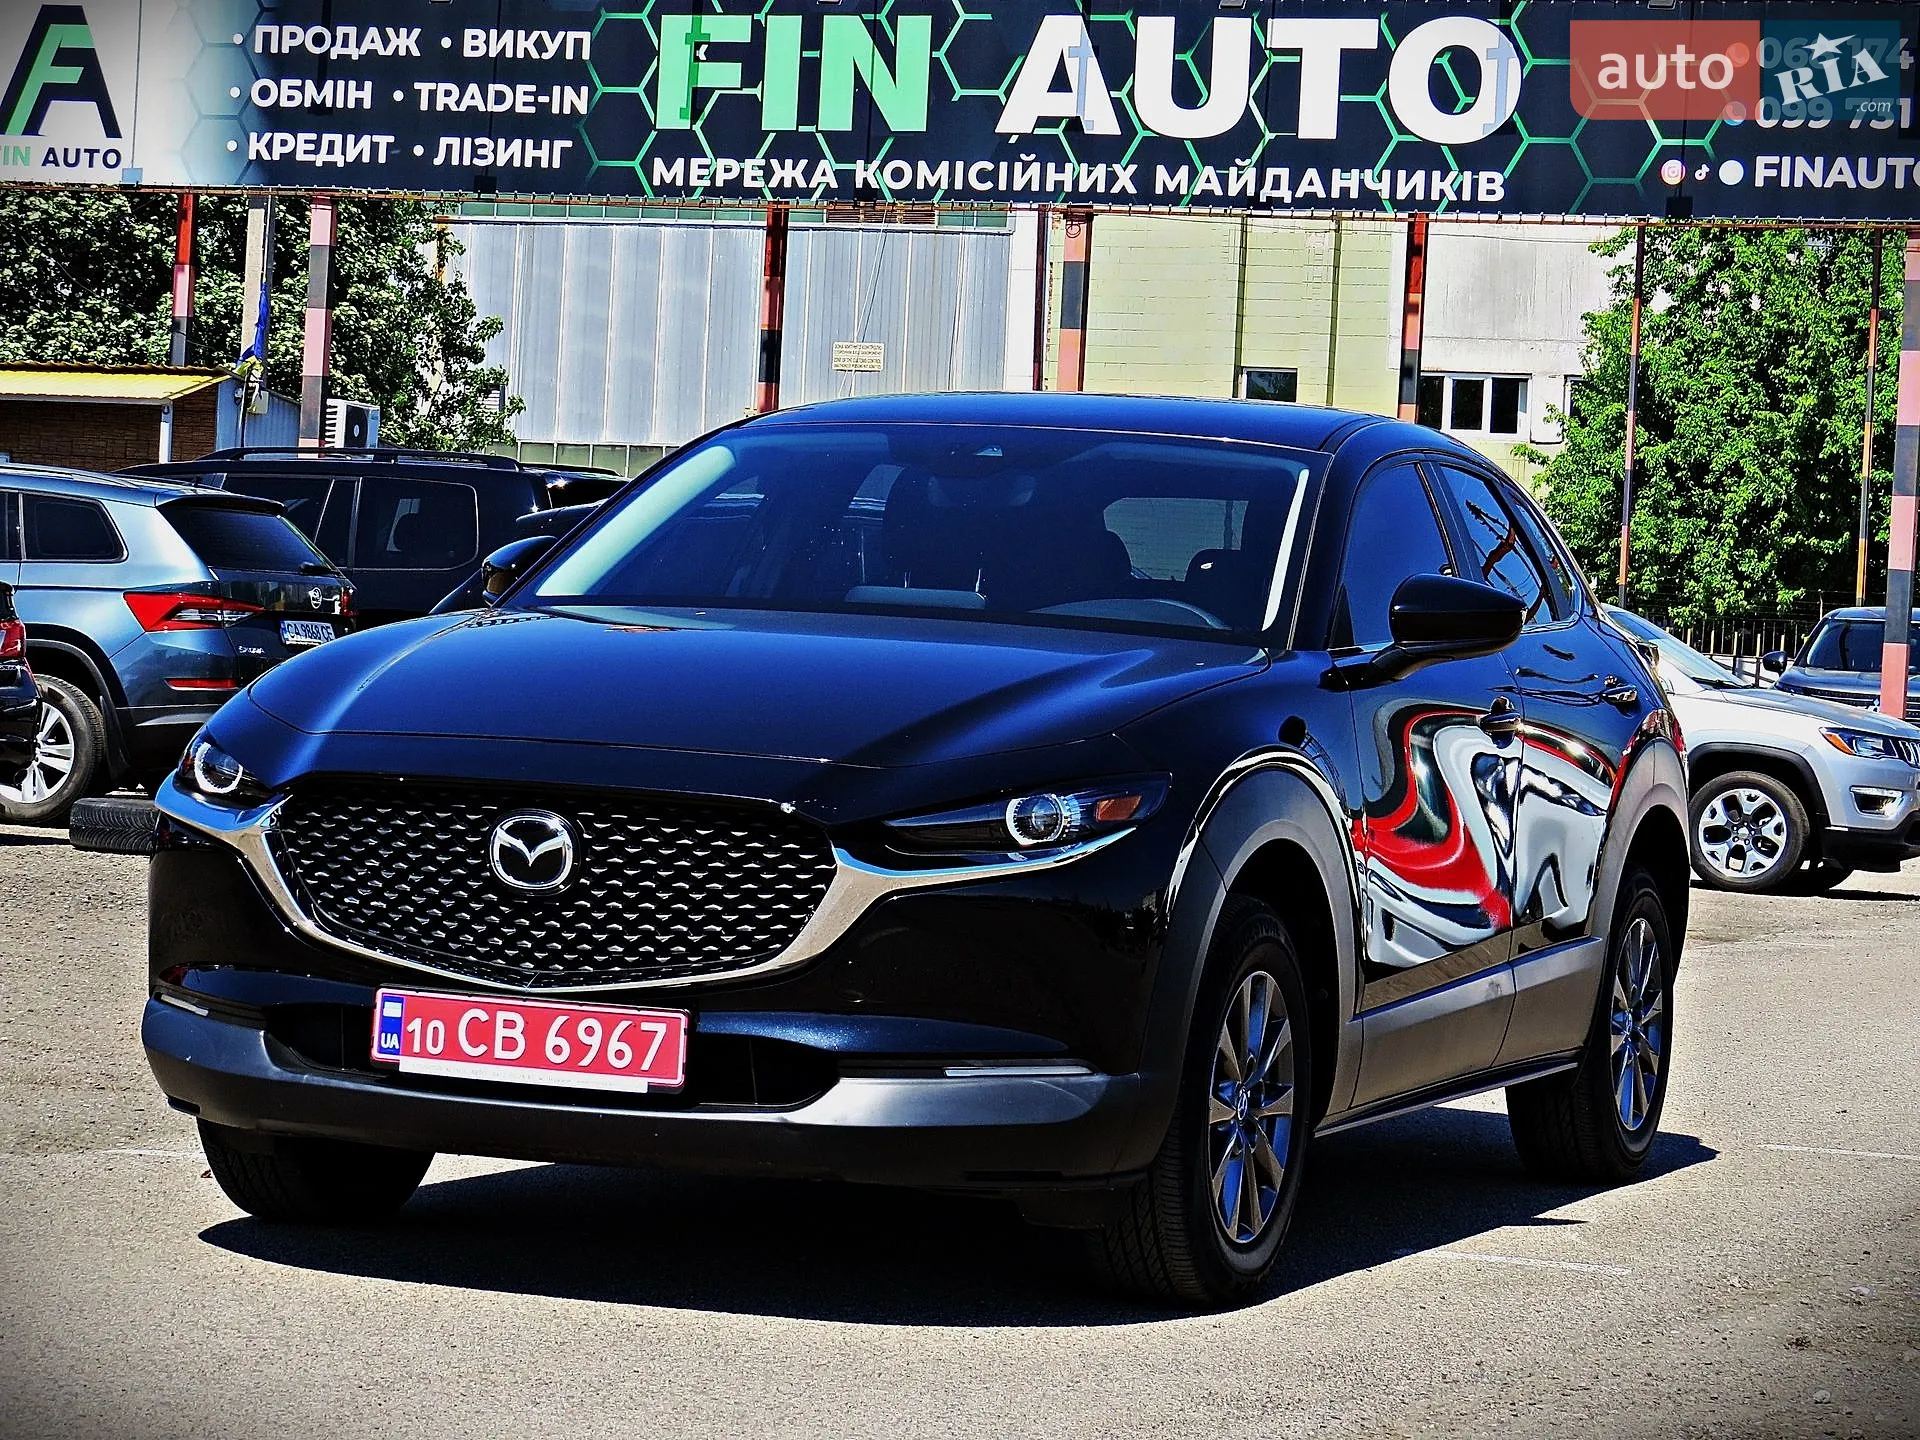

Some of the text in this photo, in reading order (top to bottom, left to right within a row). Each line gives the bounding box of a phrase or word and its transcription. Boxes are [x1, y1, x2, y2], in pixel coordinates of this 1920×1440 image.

[254, 25, 591, 61] ПРОДАЖ ВИКУП
[250, 79, 372, 110] ОБМІН
[654, 14, 1522, 144] FIN AUTO
[414, 81, 589, 115] TRADE-IN
[1755, 96, 1833, 128] 099
[0, 145, 121, 169] IN AUTO
[248, 132, 572, 169] КРЕДИТ ЛІЗИНГ
[651, 152, 1505, 203] МЕРЕЖА КОМІСІЙНИХ МАЙДАНЧИКІВ
[1755, 156, 1920, 189] FINAUT
[381, 1033, 399, 1049] UA
[406, 1008, 667, 1071] 10 CB 6967
